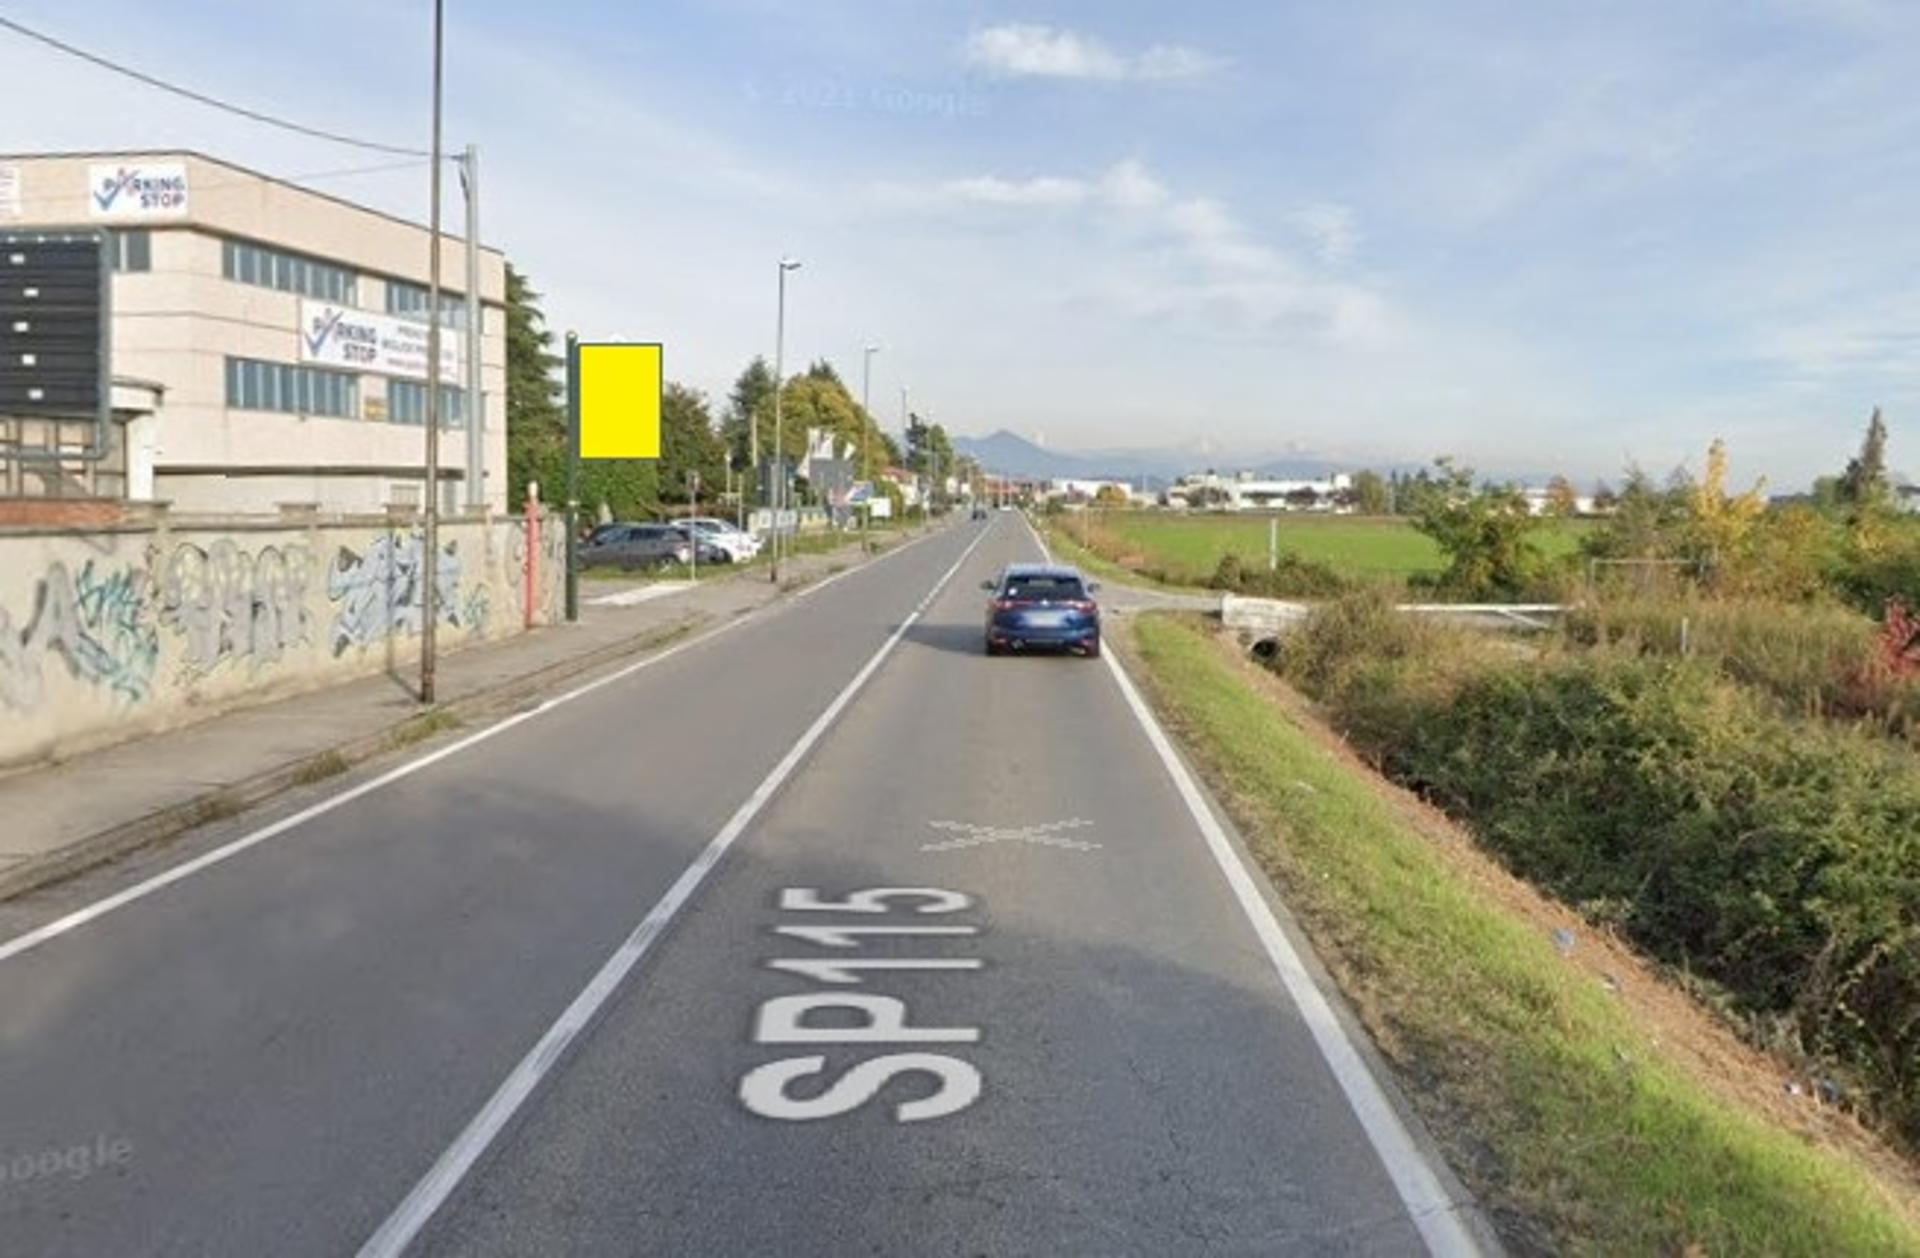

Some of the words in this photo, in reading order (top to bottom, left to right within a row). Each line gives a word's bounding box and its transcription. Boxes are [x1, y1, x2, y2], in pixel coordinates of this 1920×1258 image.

[140, 193, 185, 209] STOP
[343, 342, 376, 363] STOP
[740, 887, 982, 1122] SP115
